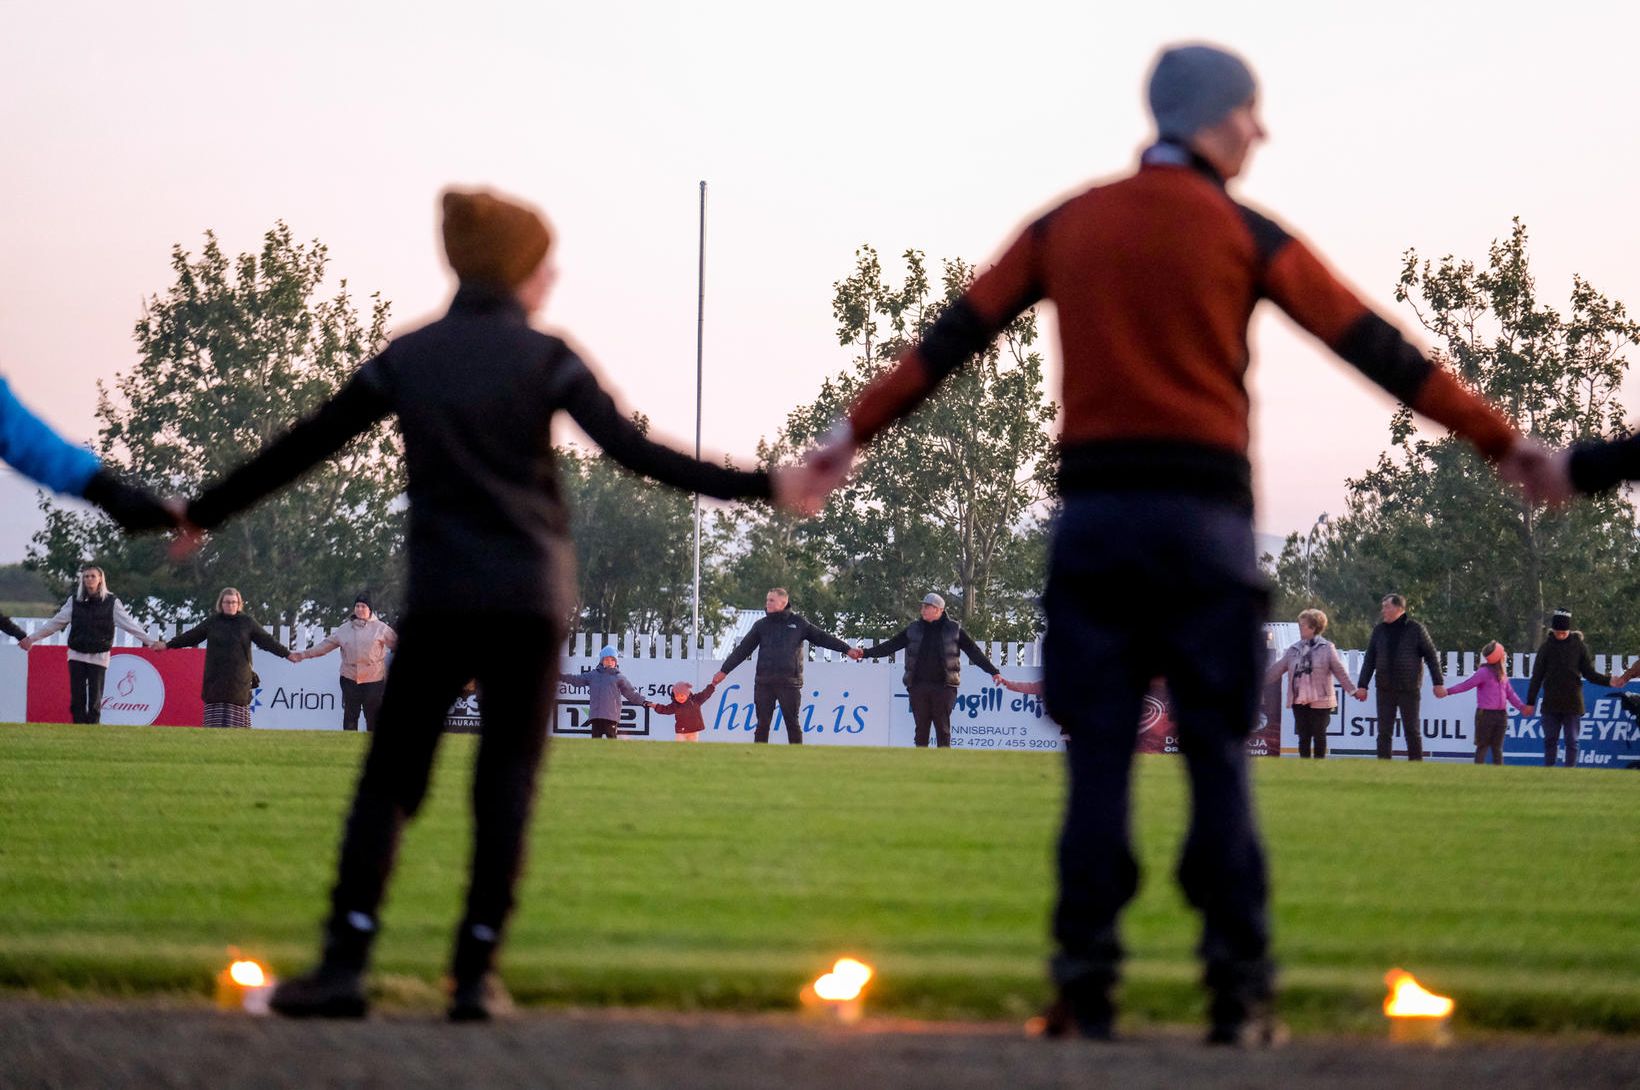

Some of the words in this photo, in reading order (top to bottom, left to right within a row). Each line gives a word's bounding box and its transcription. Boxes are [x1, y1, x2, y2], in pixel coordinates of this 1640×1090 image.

[270, 687, 334, 710] Arion
[447, 719, 481, 727] TAURAN
[951, 726, 1017, 736] NNISBRAUT
[1020, 727, 1028, 736] 3
[1350, 717, 1467, 739] STIULL
[1504, 720, 1640, 741] AKEYR
[950, 738, 964, 746] 52
[967, 738, 994, 747] 4720
[1004, 739, 1026, 748] 455
[1029, 740, 1057, 749] 9200
